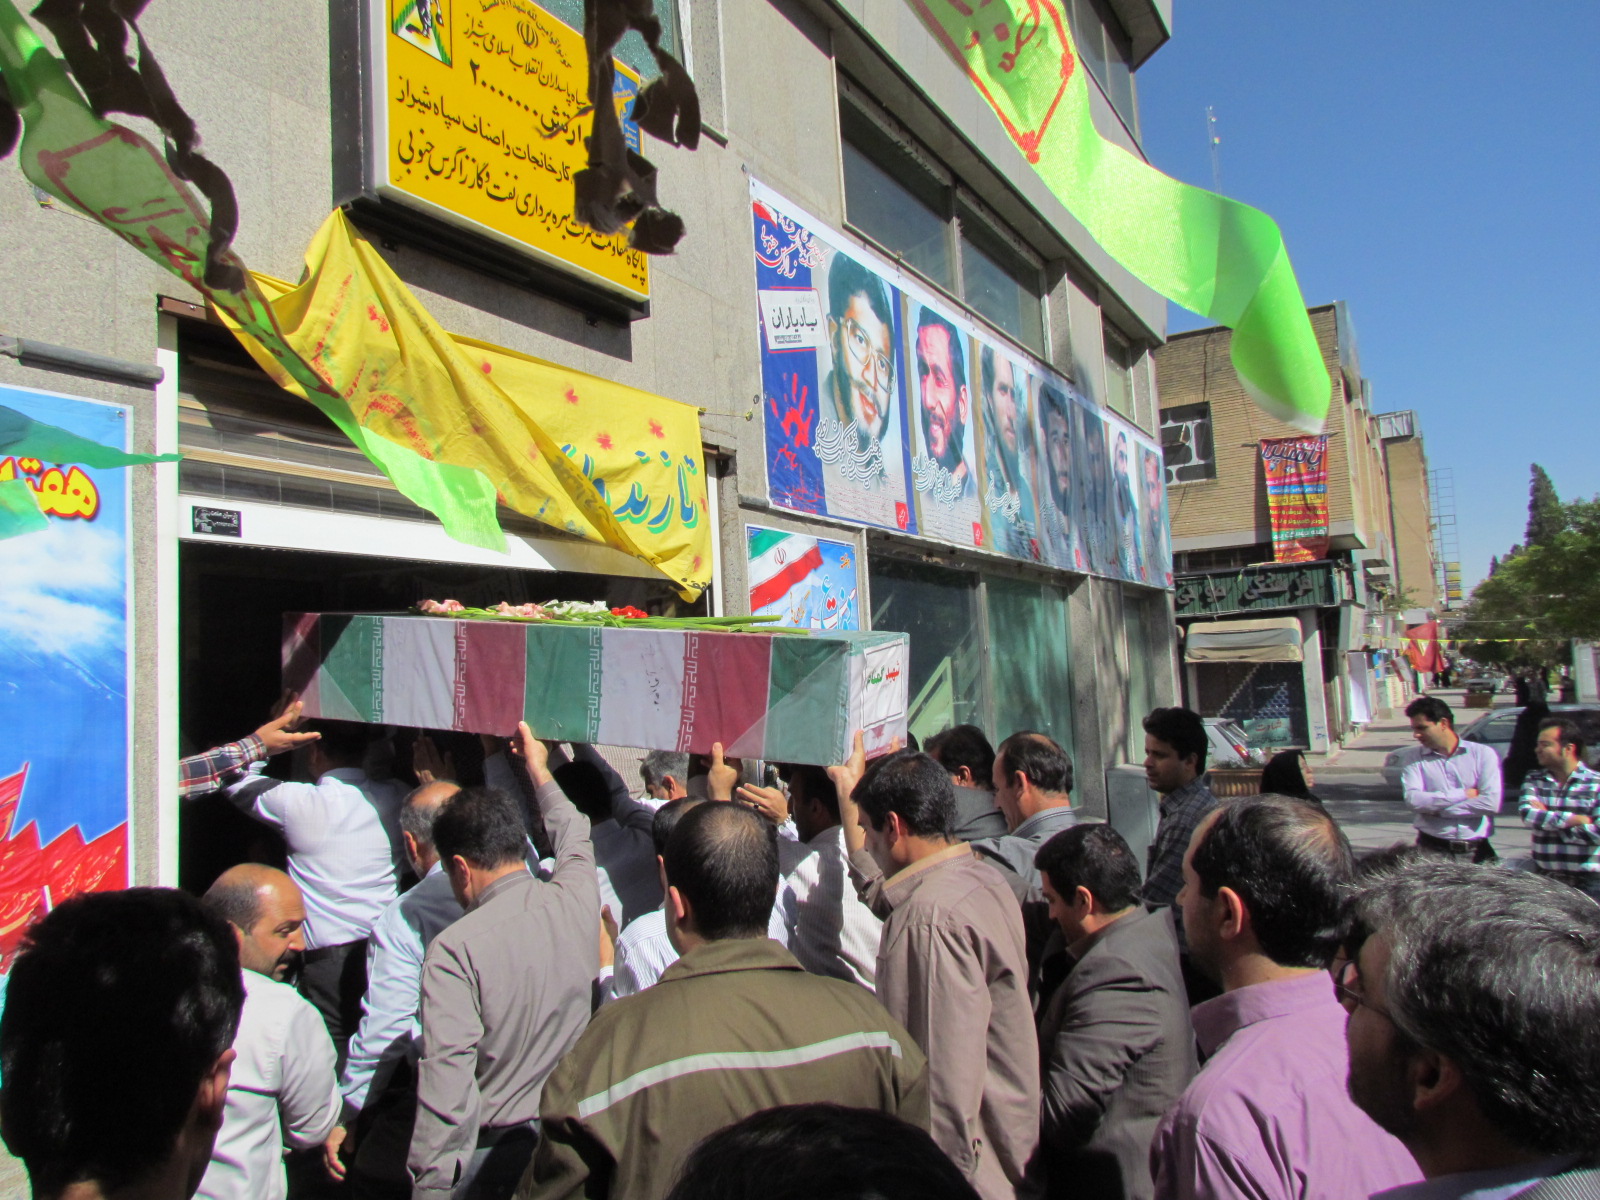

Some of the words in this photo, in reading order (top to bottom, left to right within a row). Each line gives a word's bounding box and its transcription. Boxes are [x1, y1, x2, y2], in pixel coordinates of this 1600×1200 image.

[462, 12, 489, 47] شیراز
[482, 34, 514, 56] اسلامی
[508, 56, 543, 75] انقلاب
[395, 75, 432, 115] شیراز
[538, 71, 572, 107] پاسداران
[433, 95, 461, 130] سپاه
[540, 105, 583, 145] ارتش
[462, 115, 505, 149] اصناف
[397, 128, 435, 181] جنوبی
[427, 146, 469, 184] زاگرس
[512, 143, 571, 182] کارخانجات
[467, 157, 489, 189] گاز
[485, 171, 516, 202] نفت
[771, 305, 799, 333] یاران
[886, 659, 901, 683] شهید
